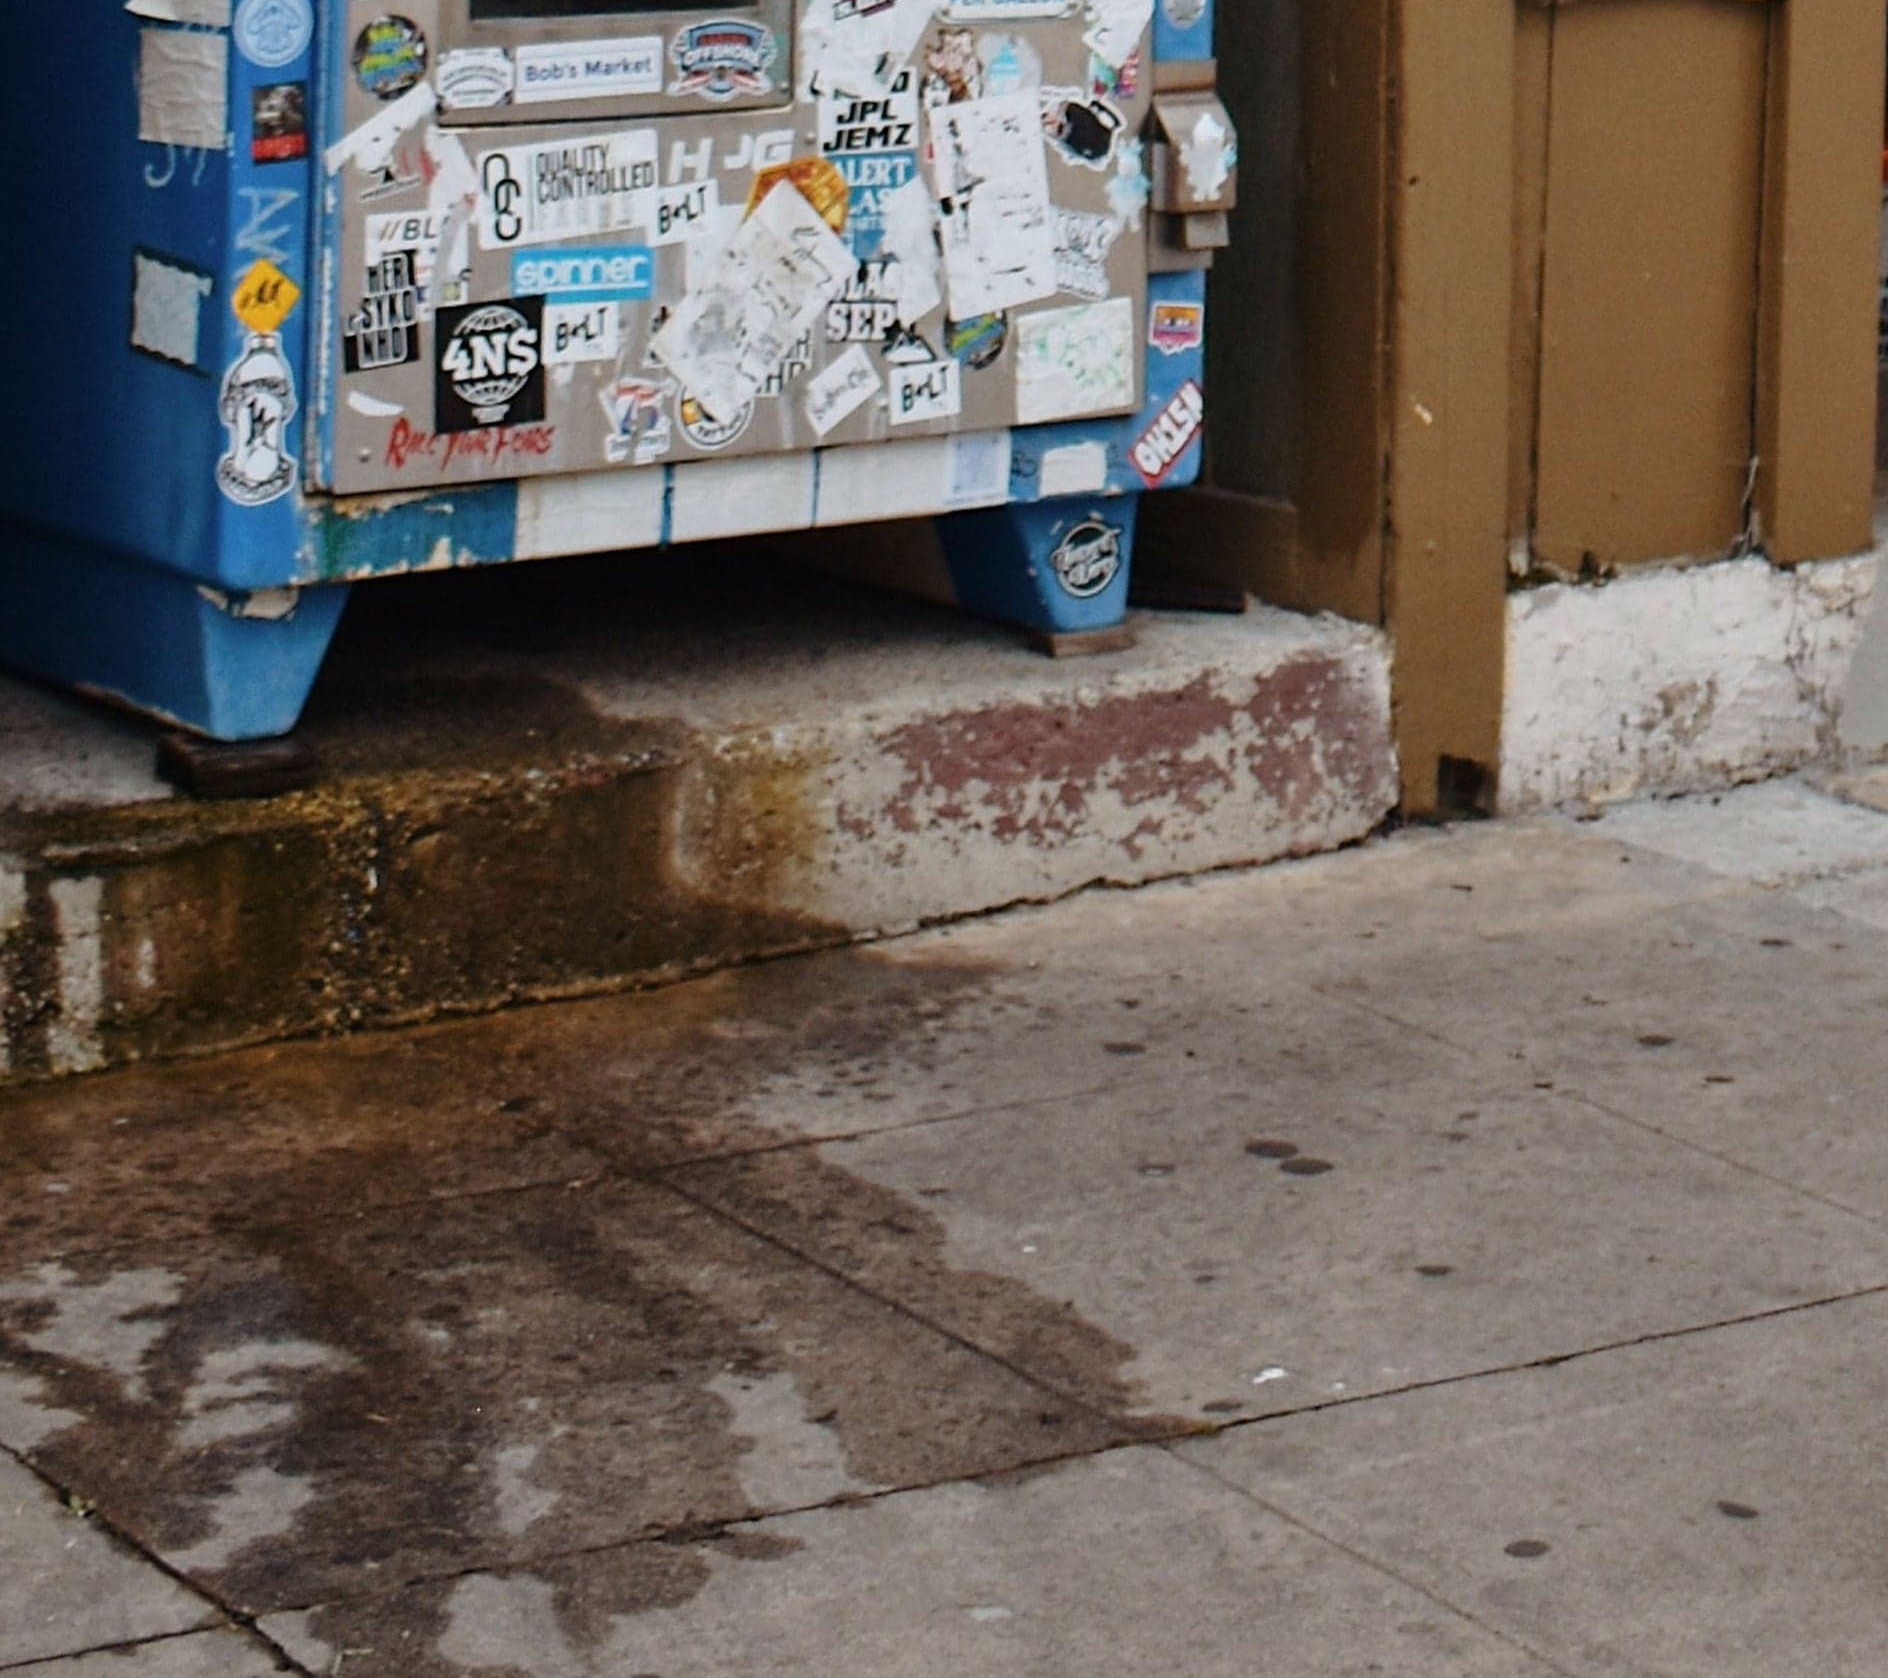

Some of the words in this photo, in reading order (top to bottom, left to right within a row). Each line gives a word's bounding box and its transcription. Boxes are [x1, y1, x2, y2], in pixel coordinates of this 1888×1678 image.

[524, 61, 577, 82] Bob's
[585, 56, 652, 77] Market
[836, 99, 900, 125] JPL
[822, 123, 912, 153] JEMZ
[536, 144, 610, 172] QUALITY
[536, 162, 654, 203] CONTROLLED
[516, 255, 650, 285] spinner
[442, 327, 538, 380] 4NS
